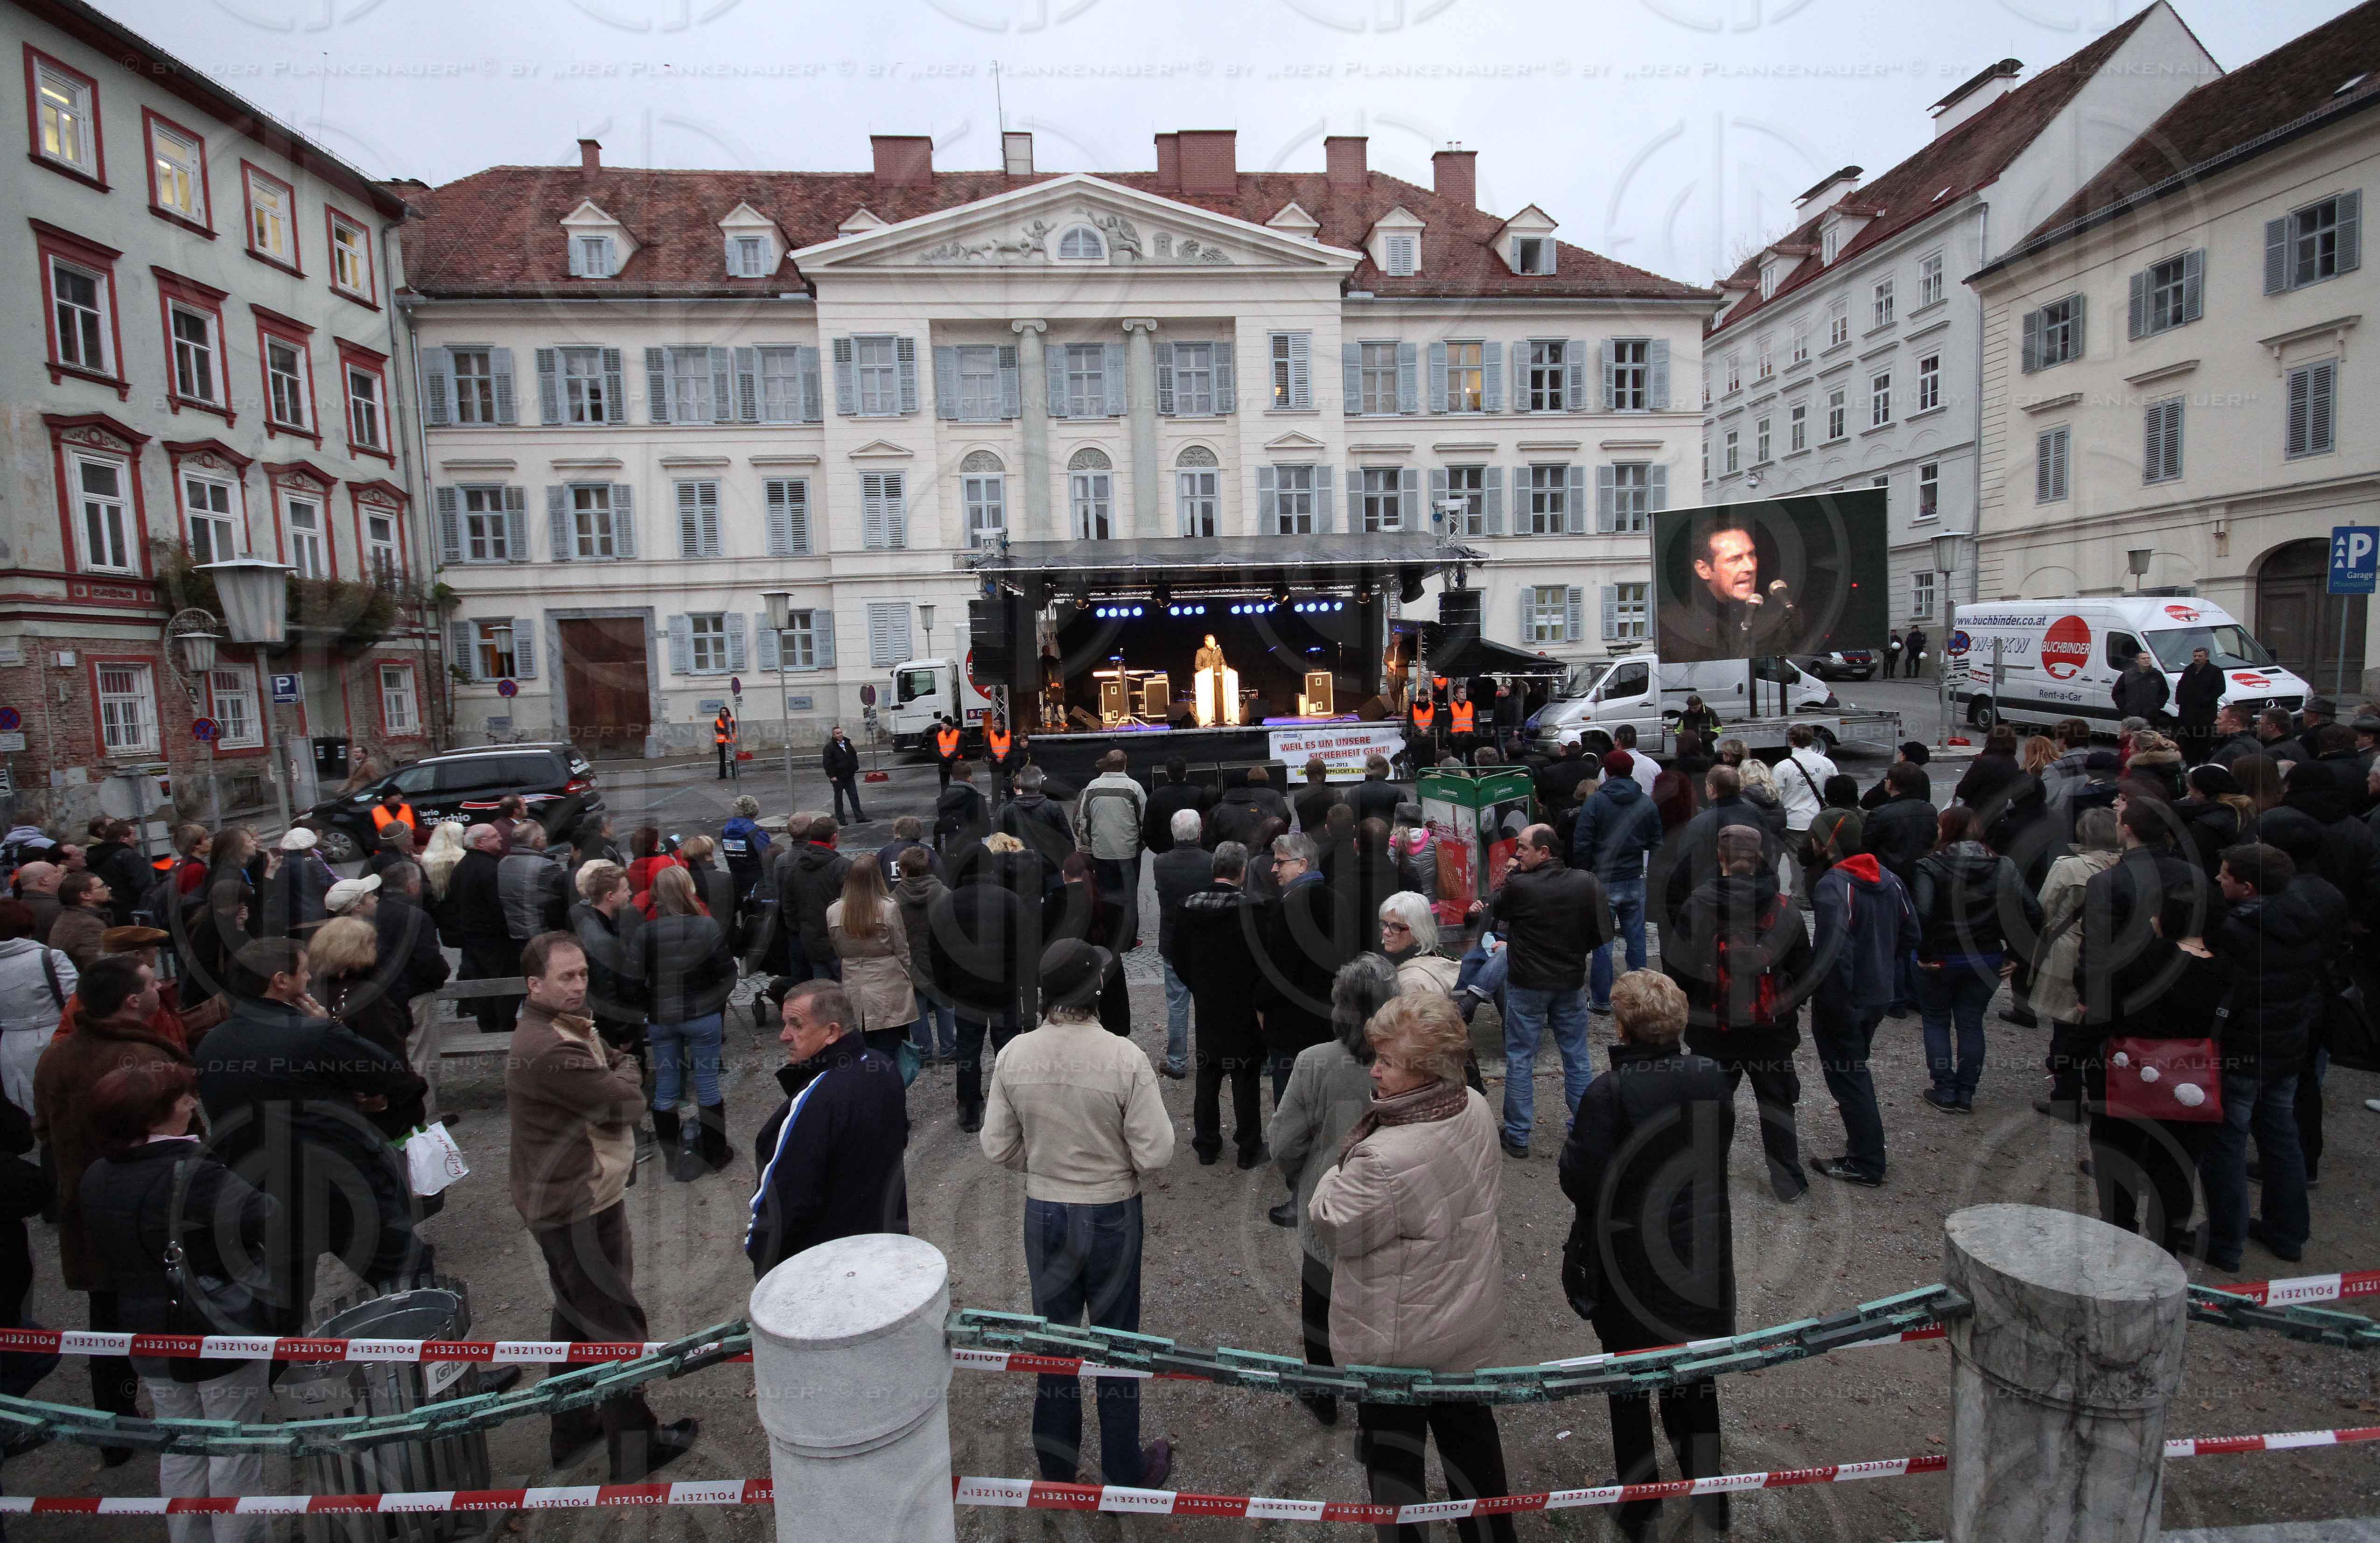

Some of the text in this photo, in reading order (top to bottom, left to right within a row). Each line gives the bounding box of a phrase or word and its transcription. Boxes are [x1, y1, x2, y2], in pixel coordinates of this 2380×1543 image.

[2347, 533, 2373, 568] P
[2347, 572, 2373, 580] Garage
[2042, 641, 2091, 654] BUCHBINDER
[276, 677, 290, 694] P
[2039, 689, 2082, 701] Rent-a-Car
[1280, 743, 1303, 751] WEIL
[1336, 736, 1371, 746] UNSERE
[1309, 746, 1390, 759] SICHERHEIT GEHT!
[2284, 1287, 2334, 1298] POLIZEI
[73, 1338, 125, 1348] POLIZEI
[144, 1340, 196, 1350] POLIZEI
[216, 1343, 268, 1352] POLIZEI
[287, 1343, 342, 1354] POLIZEI
[361, 1345, 415, 1354] POLIZEI
[508, 1347, 562, 1355] POLIZEI
[582, 1346, 637, 1355] POLIZEI
[971, 1460, 1903, 1515] POLIZEI POLIZEI POLIZEI POLIZEI POLIZEI POLIZEI POLIZEI POLIZEI POLIZEI POLIZEI POLIZEI POLIZEI POLIZEI
[463, 1501, 518, 1511] POLIZEI
[537, 1498, 589, 1509] POLIZEI
[609, 1495, 663, 1505] POLIZEI
[682, 1492, 735, 1502] POLIZEI
